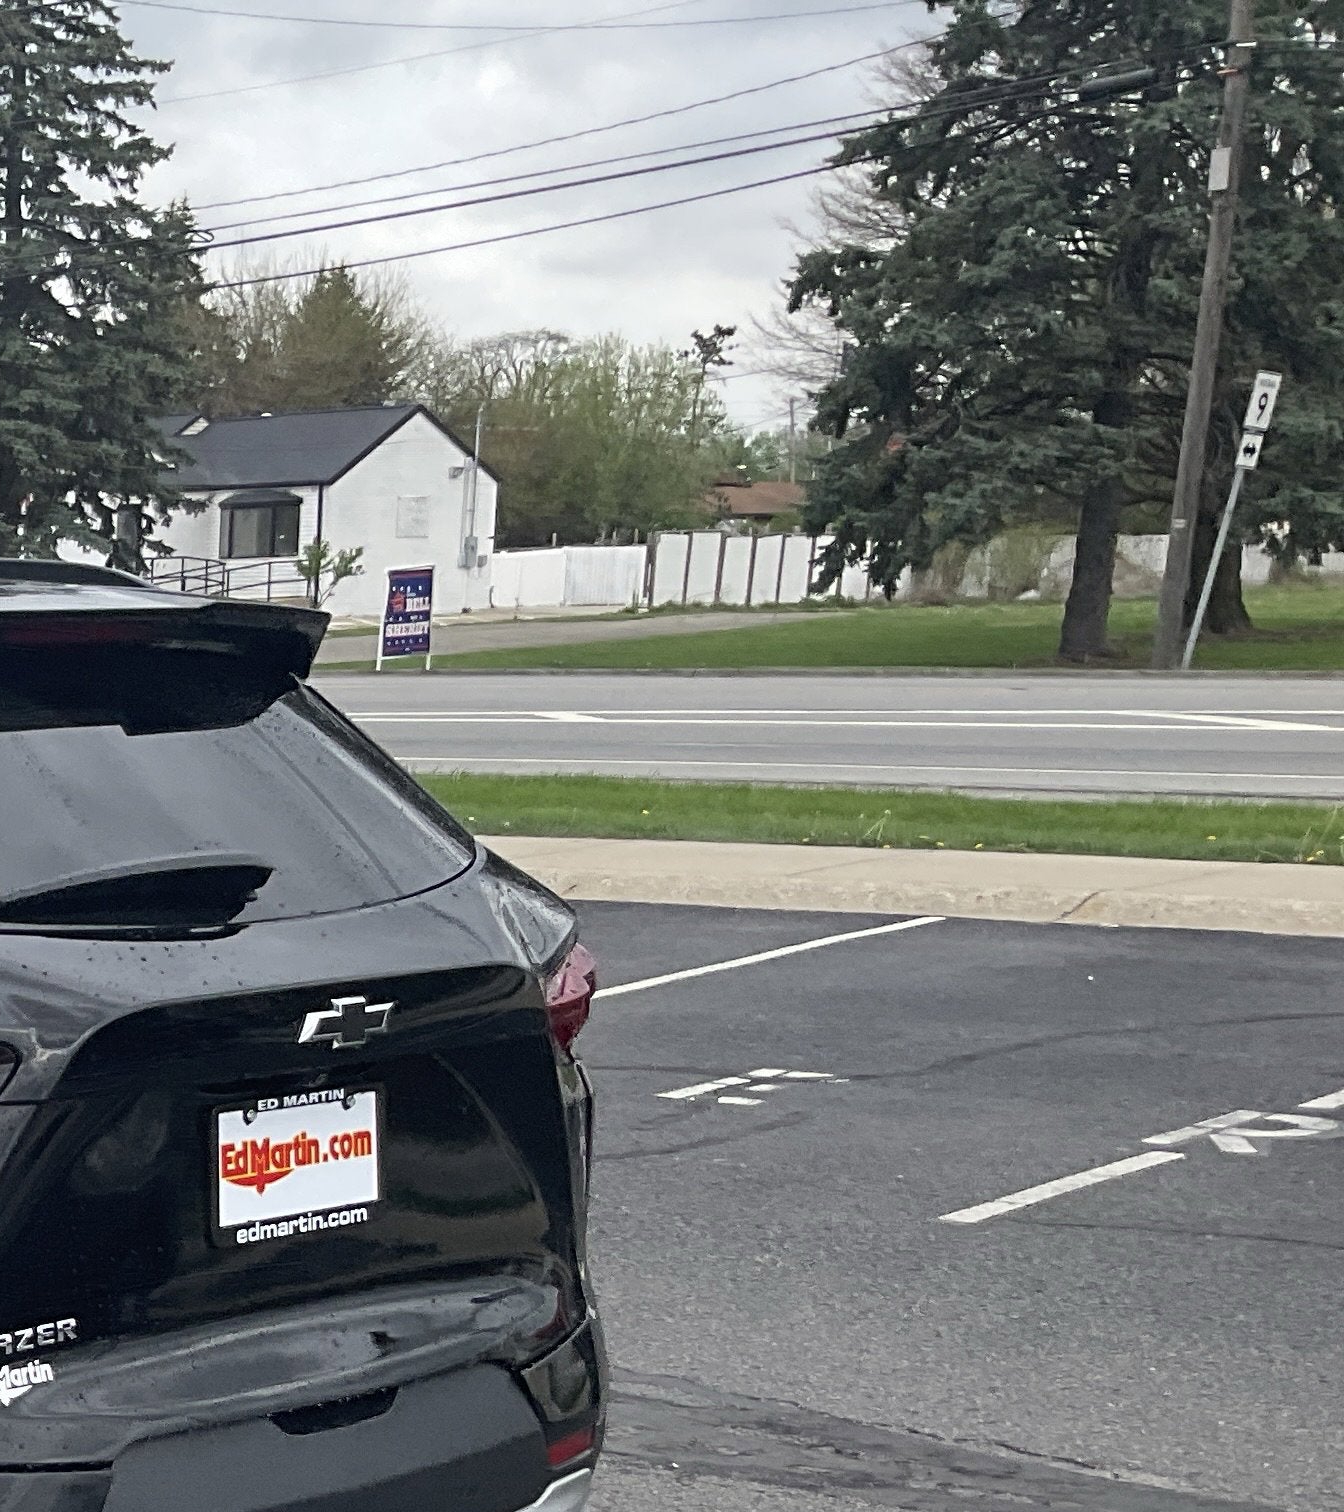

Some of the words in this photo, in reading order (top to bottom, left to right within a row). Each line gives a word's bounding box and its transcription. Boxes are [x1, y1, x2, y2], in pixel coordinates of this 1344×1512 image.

[1256, 392, 1269, 422] 9
[257, 1098, 279, 1111] ED
[283, 1089, 345, 1107] MARTIN
[220, 1130, 373, 1180] EdMartin.com
[236, 1206, 368, 1244] edmartin.com
